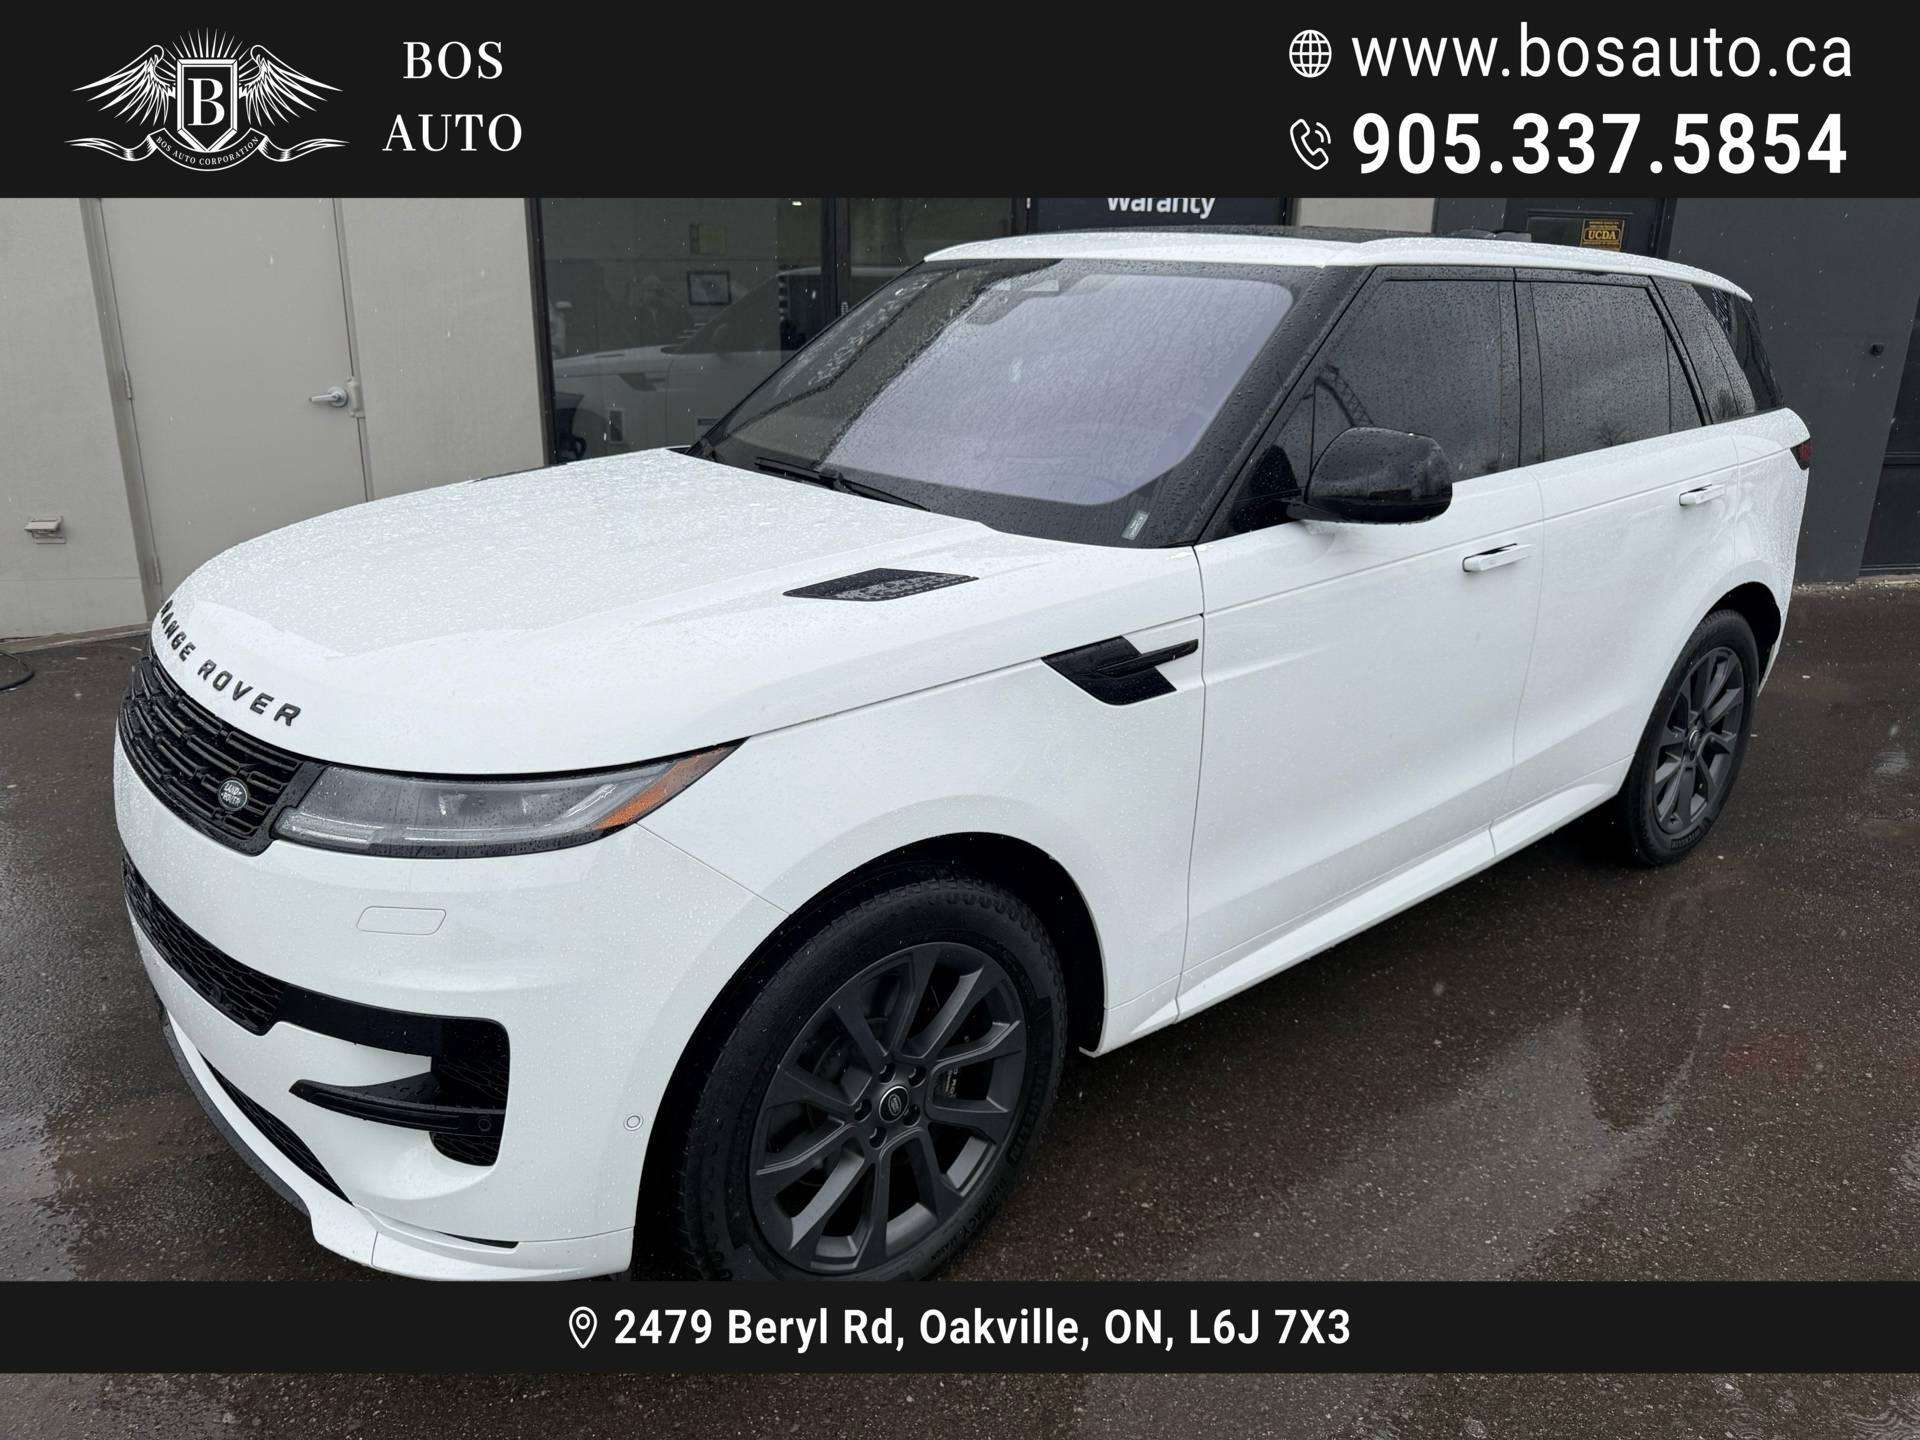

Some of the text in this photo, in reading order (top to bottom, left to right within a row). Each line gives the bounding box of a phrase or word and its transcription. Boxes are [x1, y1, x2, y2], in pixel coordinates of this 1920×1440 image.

[1588, 230, 1616, 240] UCDA
[160, 600, 301, 726] RANGE ROVER
